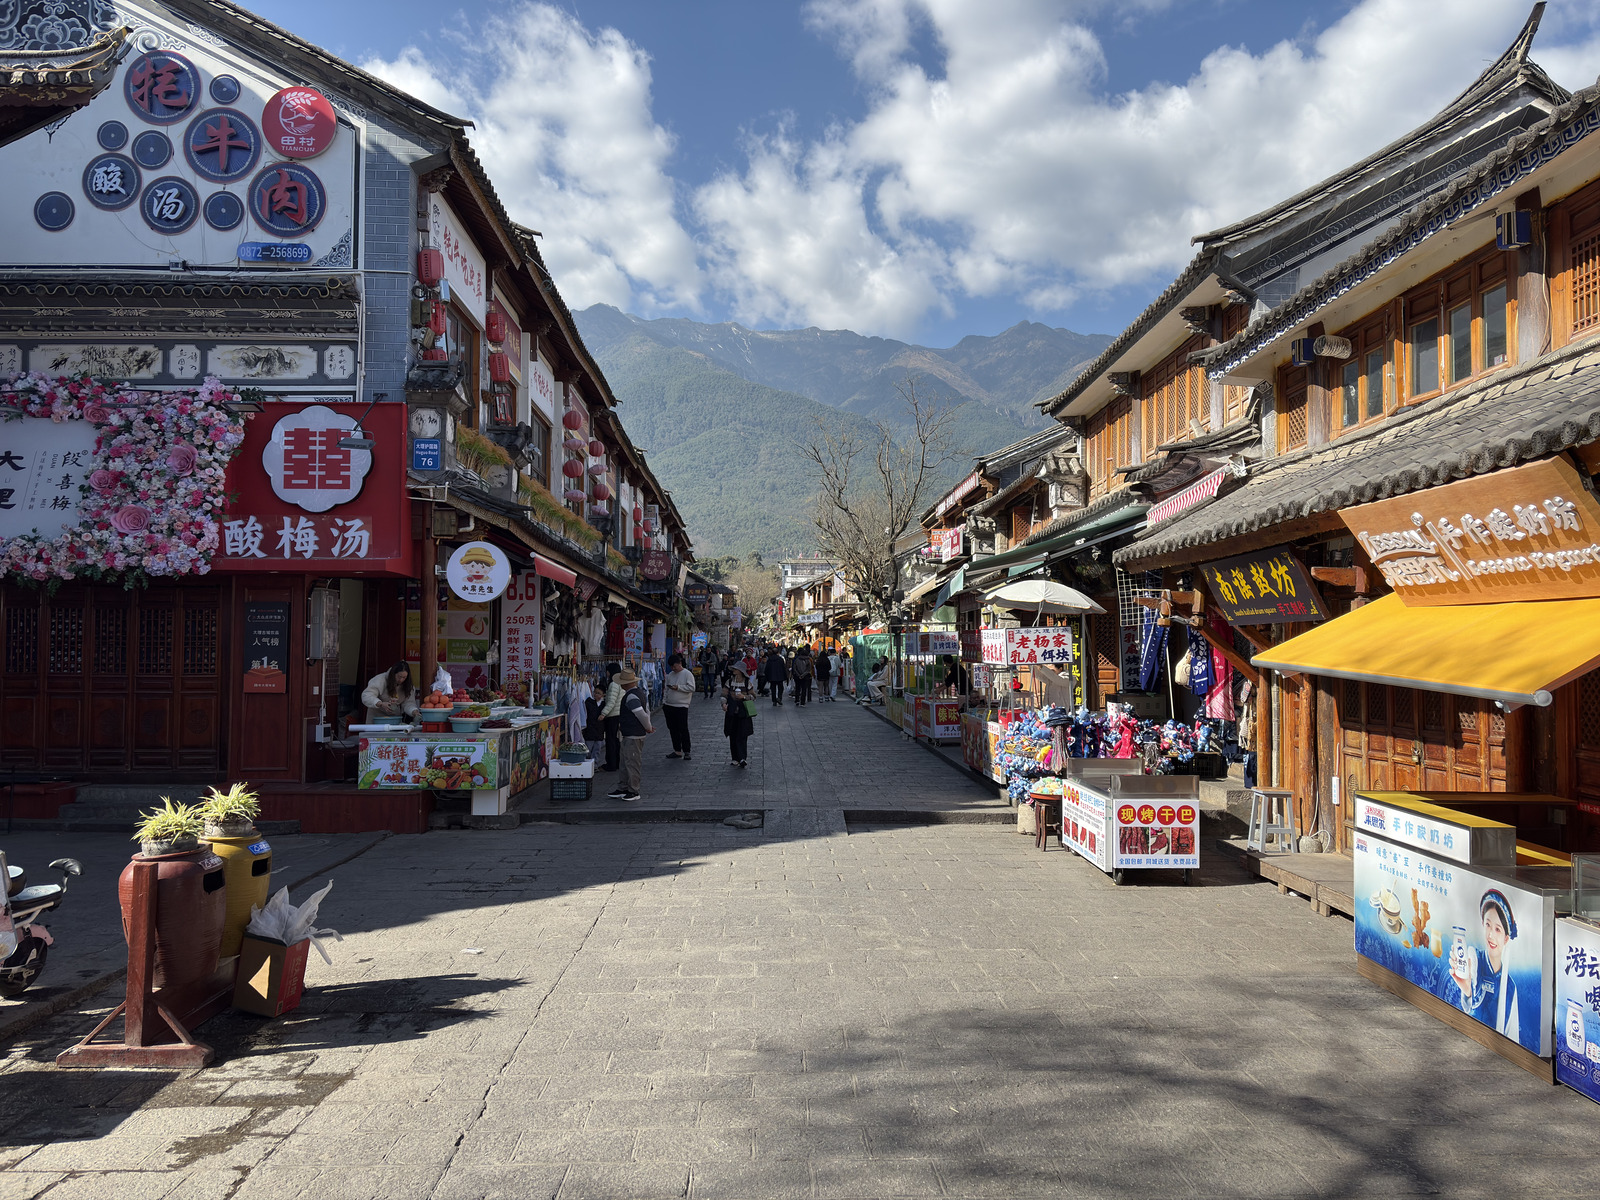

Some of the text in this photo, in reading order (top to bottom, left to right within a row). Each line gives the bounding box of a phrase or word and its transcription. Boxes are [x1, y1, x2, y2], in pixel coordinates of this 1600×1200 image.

[281, 136, 315, 145] 田村
[421, 457, 433, 466] 76
[49, 451, 83, 511] 段喜梅
[1437, 495, 1585, 551] 手作酸奶坊
[223, 515, 370, 559] 酸梅汤
[1466, 555, 1533, 576] Lesson
[461, 584, 494, 594] 水果先生
[507, 573, 536, 602] 8.6
[1255, 607, 1264, 615] drum
[1263, 606, 1277, 615] square
[1277, 600, 1307, 617] 手工制作
[506, 615, 536, 626] 250克
[252, 637, 280, 647] 人气榜
[934, 634, 957, 642] 特色小吃
[1015, 633, 1069, 649] 老杨家
[251, 656, 279, 669] 第1名
[506, 627, 521, 695] 新鲜水果大拼盘
[523, 633, 534, 682] 现切现卖
[1010, 647, 1070, 664] 乳扇 饵块
[974, 665, 982, 687] 烤乳扇
[377, 745, 408, 760] 新鲜
[391, 759, 421, 773] 水果
[1120, 807, 1194, 822] 现烤干巴
[1392, 817, 1454, 850] 手作酸奶坊
